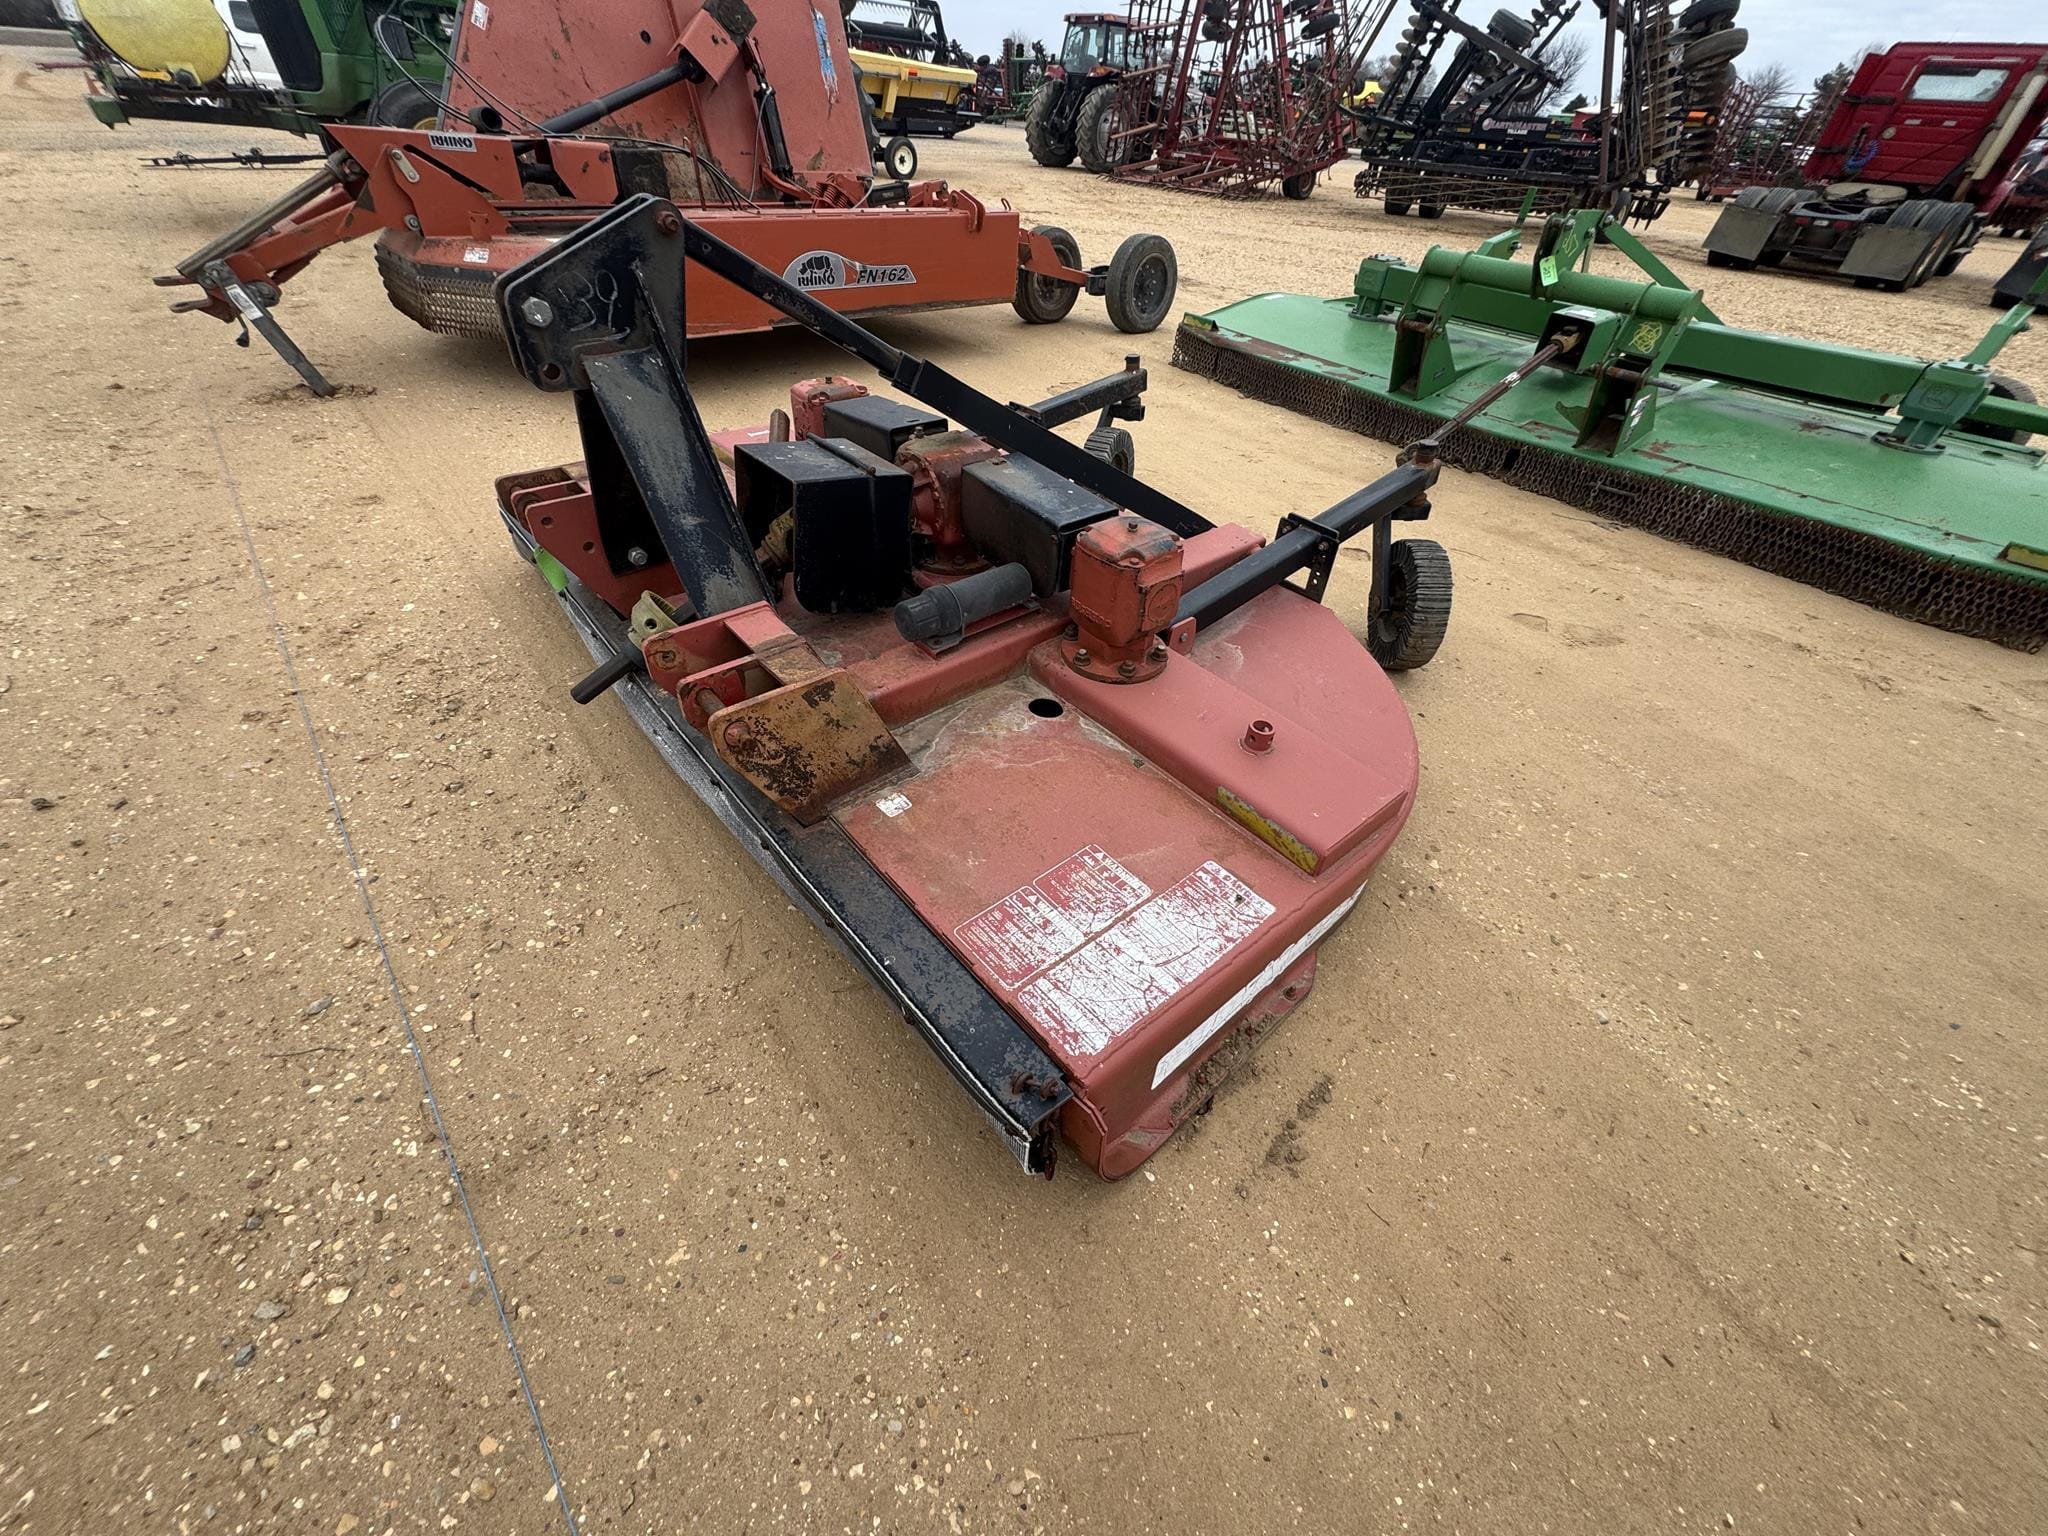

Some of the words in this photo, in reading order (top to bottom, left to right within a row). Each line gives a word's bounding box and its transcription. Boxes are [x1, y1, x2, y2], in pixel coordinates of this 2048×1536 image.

[430, 134, 473, 149] RHINO
[797, 271, 836, 287] RHINO
[857, 266, 908, 285] FN162
